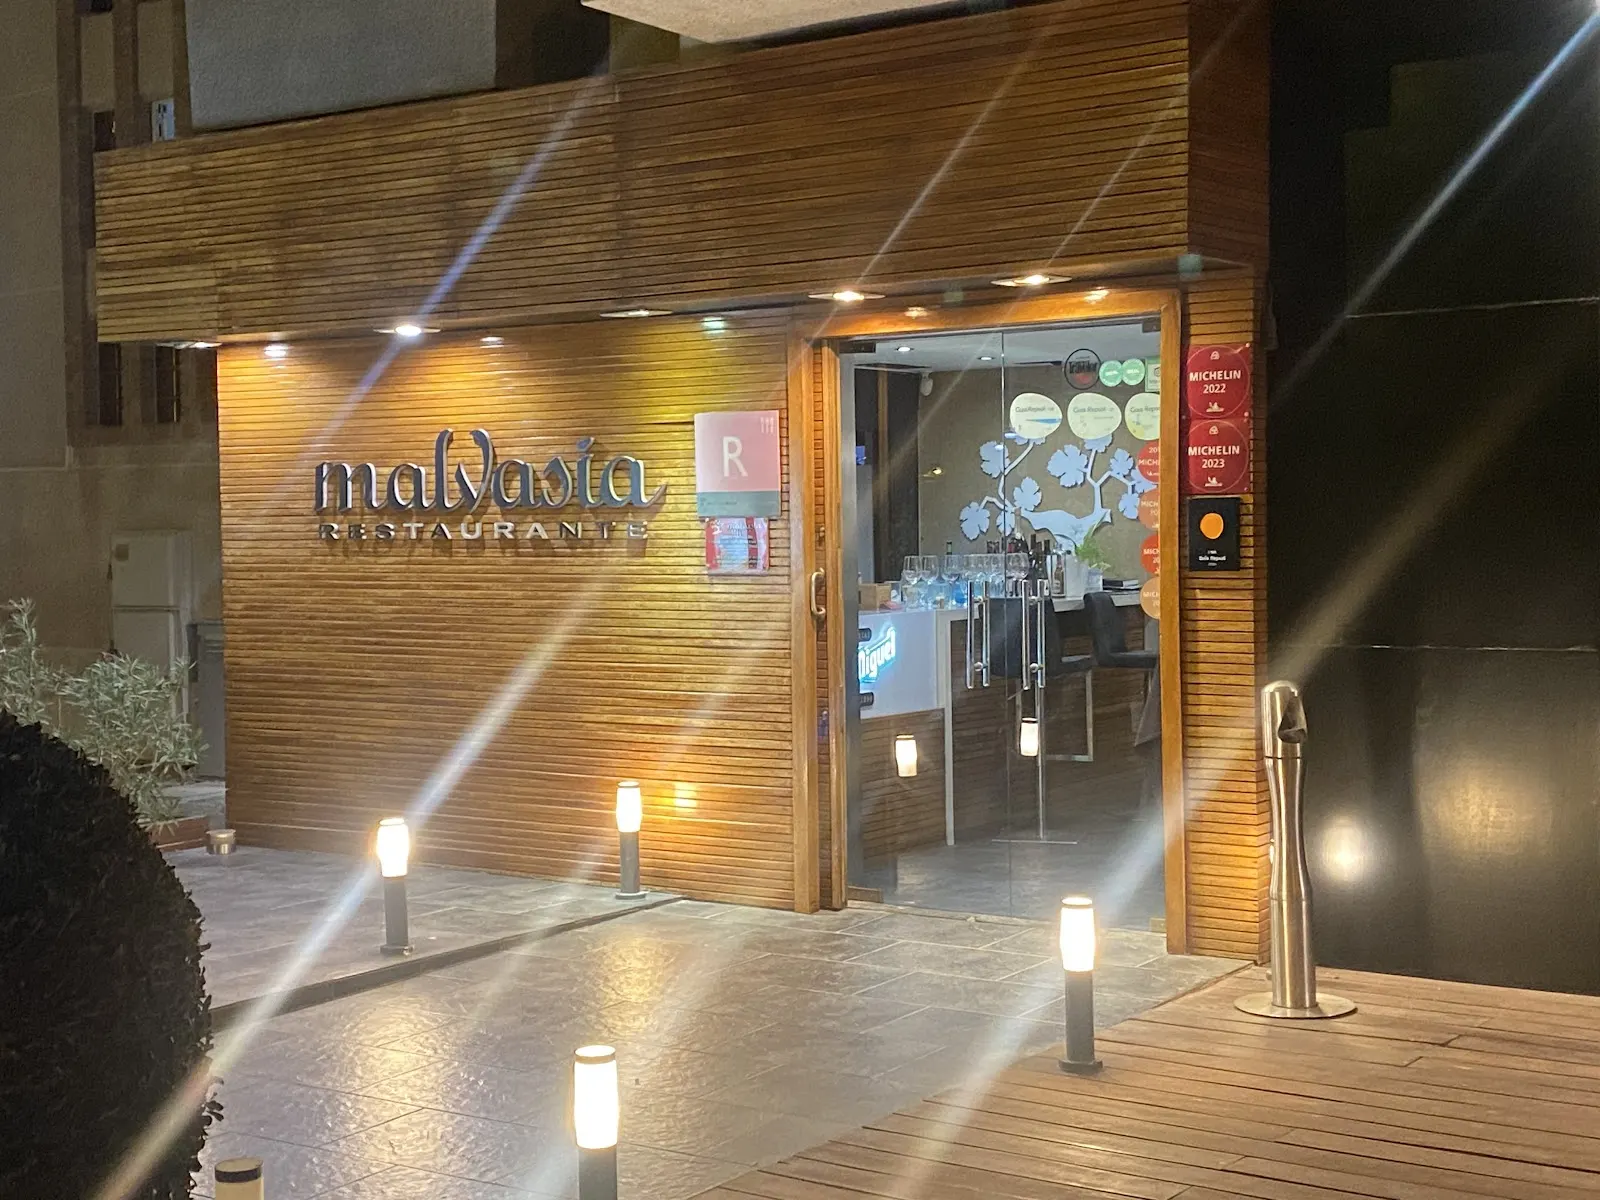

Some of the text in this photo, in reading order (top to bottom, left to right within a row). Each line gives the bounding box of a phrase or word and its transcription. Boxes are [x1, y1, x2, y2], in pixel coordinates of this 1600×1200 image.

[1189, 370, 1241, 382] MICHELIN
[1202, 384, 1226, 394] 2022
[1188, 445, 1240, 456] MICHELIN
[722, 436, 748, 477] R
[1202, 459, 1225, 468] 2023
[1140, 500, 1160, 508] MICH
[318, 521, 649, 540] RESTAURANTE
